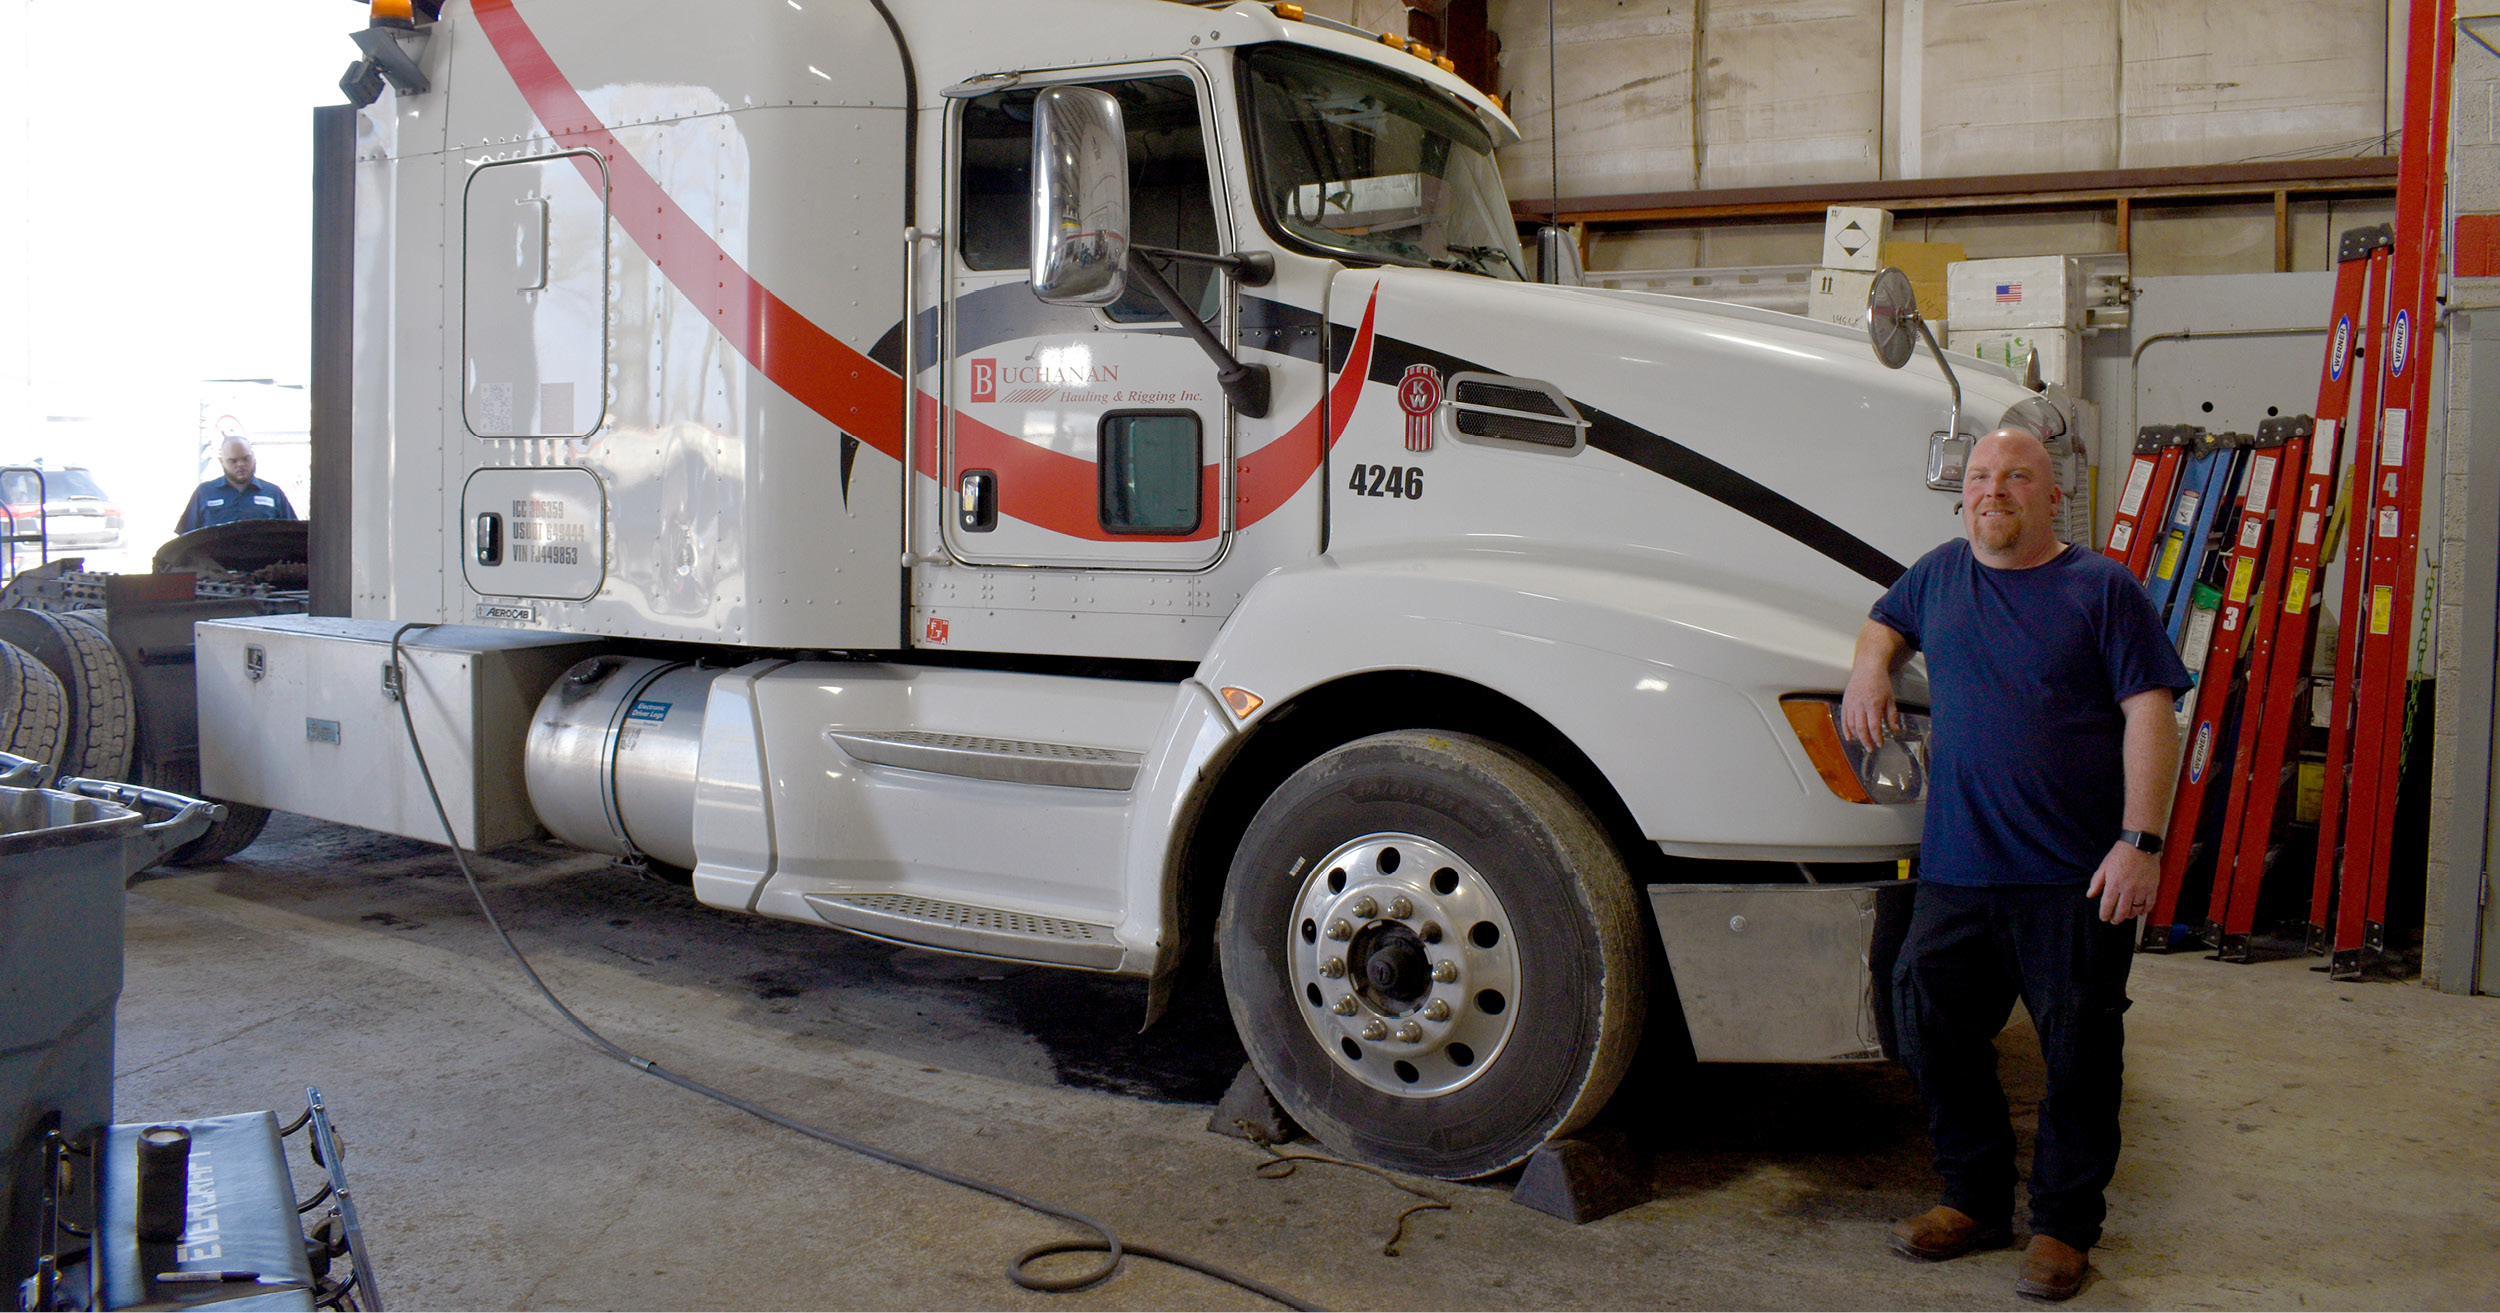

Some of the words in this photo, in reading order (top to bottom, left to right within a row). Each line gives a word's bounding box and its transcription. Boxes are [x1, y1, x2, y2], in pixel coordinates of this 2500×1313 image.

[2333, 327, 2346, 367] WERNER
[2394, 322, 2405, 363] WERNER
[1060, 391, 1109, 405] Hauling
[1113, 391, 1124, 402] &
[1128, 391, 1177, 405] Rigging
[1180, 390, 1203, 401] Inc.
[1348, 463, 1424, 500] 4246
[2382, 472, 2398, 498] 4
[2309, 483, 2320, 508] 1
[512, 500, 527, 518] ICC
[513, 521, 543, 540] USDOT
[512, 544, 528, 563] VIN
[530, 545, 578, 565] FJ449853
[486, 607, 529, 619] AEROCAB
[2222, 606, 2239, 631] 3
[632, 709, 650, 717] Driver
[637, 702, 666, 712] Electronic
[2194, 731, 2207, 769] WERNER
